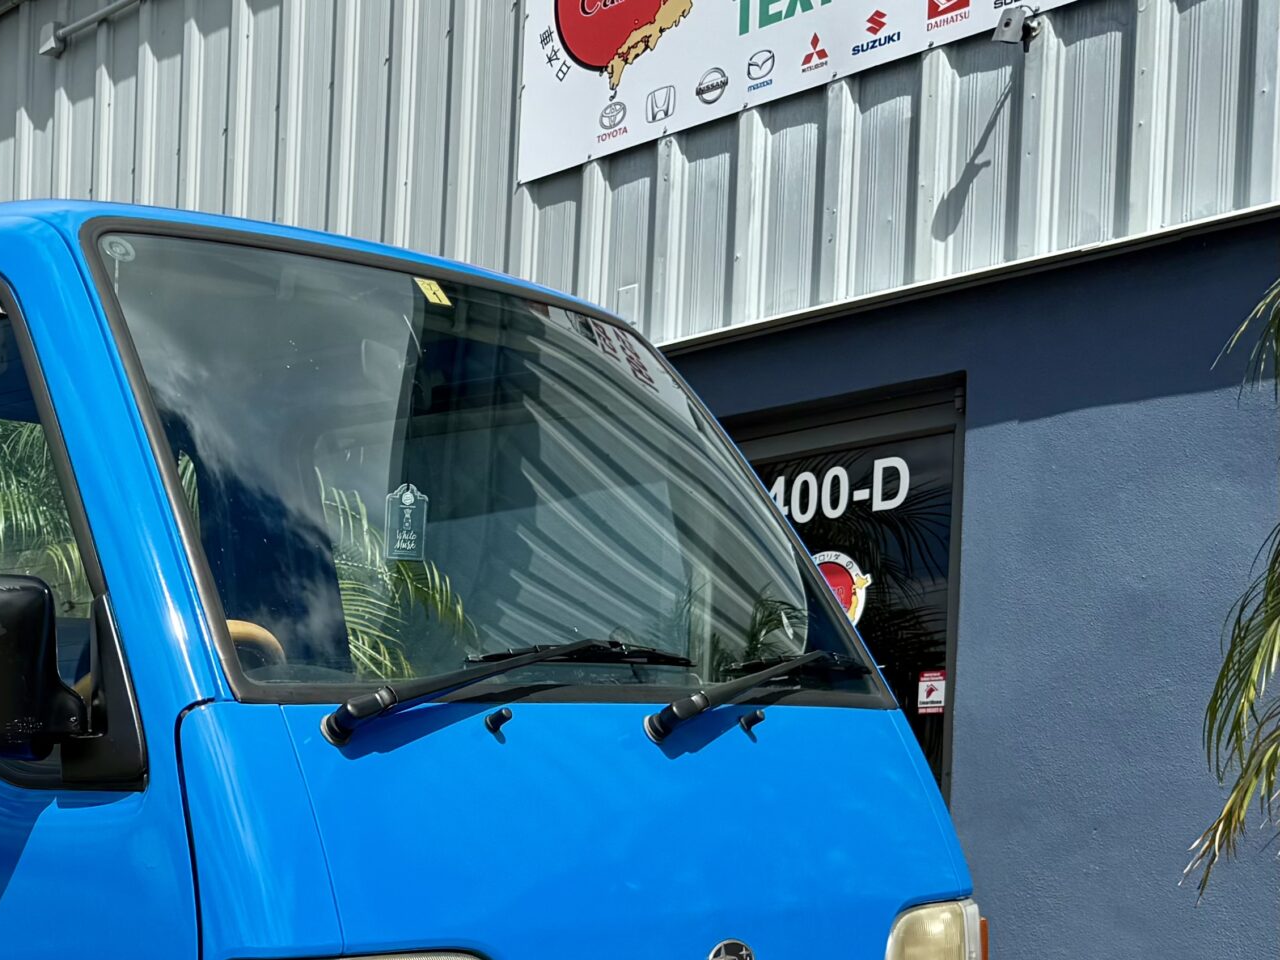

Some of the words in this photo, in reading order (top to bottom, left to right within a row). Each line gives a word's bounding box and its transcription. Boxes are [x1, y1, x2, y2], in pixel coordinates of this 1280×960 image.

[926, 10, 970, 32] DAIHATSU
[851, 31, 901, 56] SUZUKI
[696, 79, 728, 95] NISSAN
[597, 126, 628, 143] TOYOTA
[770, 456, 910, 523] 400-D
